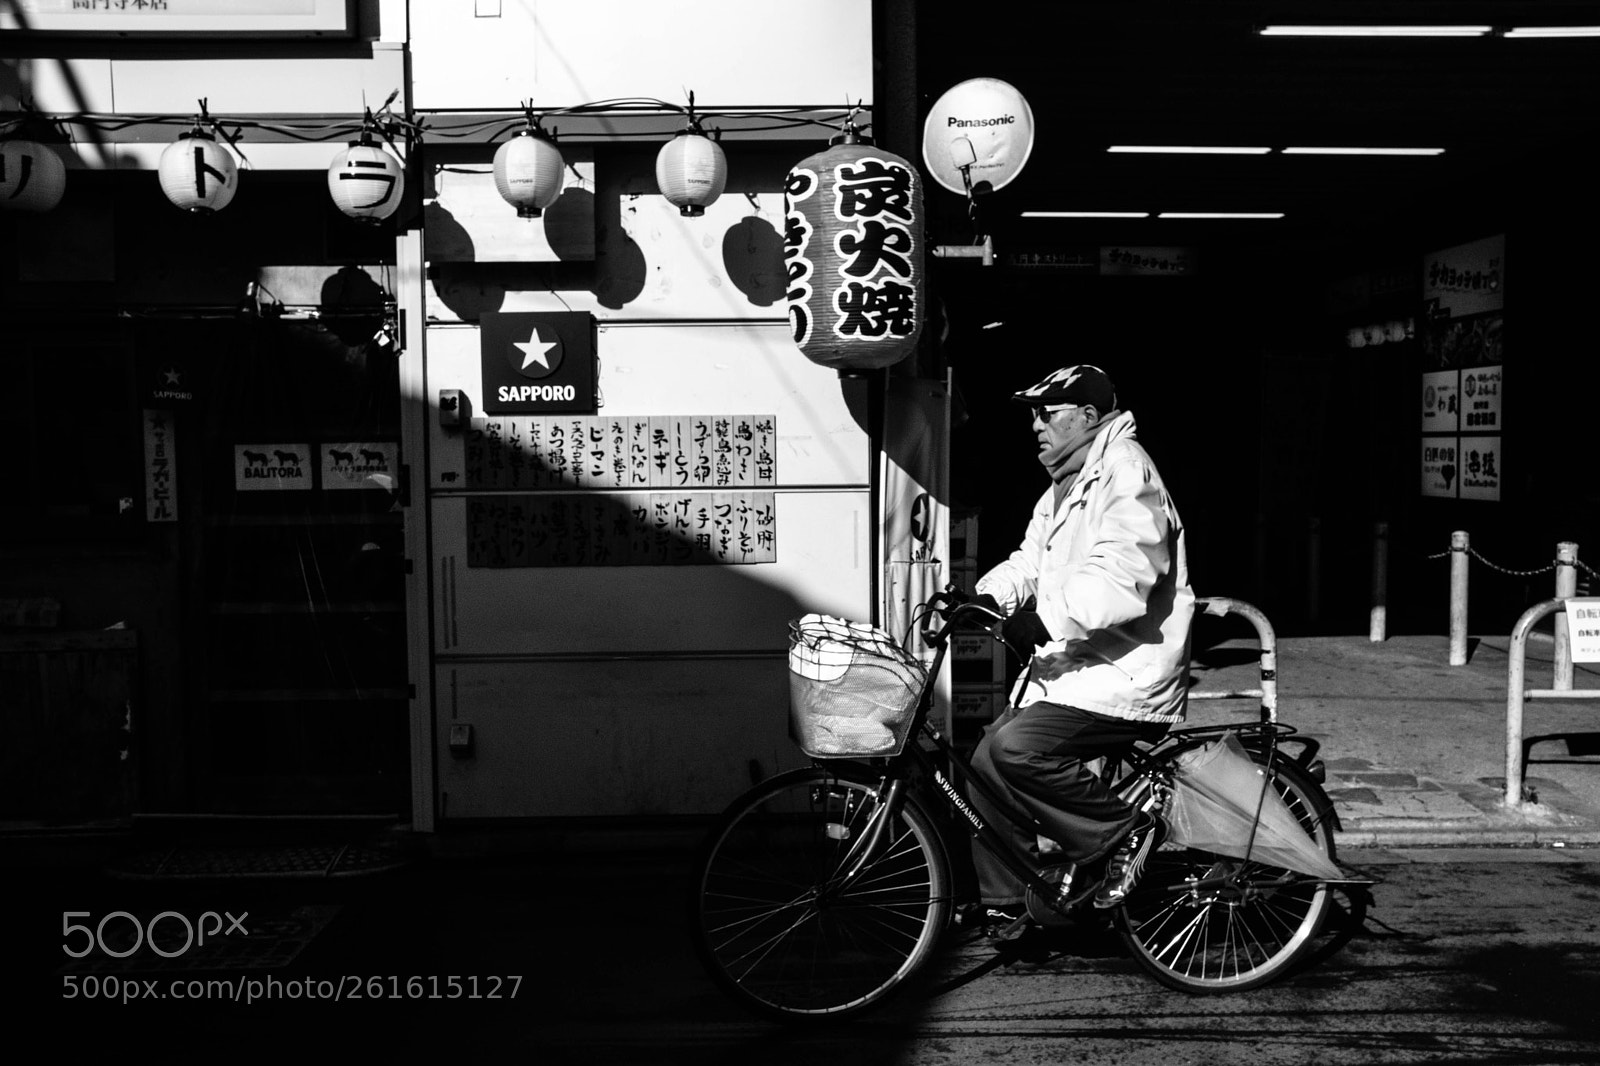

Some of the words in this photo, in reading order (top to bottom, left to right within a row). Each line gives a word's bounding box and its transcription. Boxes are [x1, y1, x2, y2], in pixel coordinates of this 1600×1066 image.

[948, 114, 1015, 128] Panasonic
[193, 146, 226, 199] ト
[339, 160, 396, 209] ラ
[833, 157, 917, 341] 炭火焼
[152, 390, 193, 400] SAPPORO
[498, 384, 576, 402] SAPPORO
[244, 466, 303, 479] BALITORA
[632, 422, 647, 483] ぎんなん
[653, 429, 669, 475] ネギ
[675, 422, 689, 485] ししとう
[695, 508, 711, 551] 手羽
[1576, 608, 1600, 620] 自転
